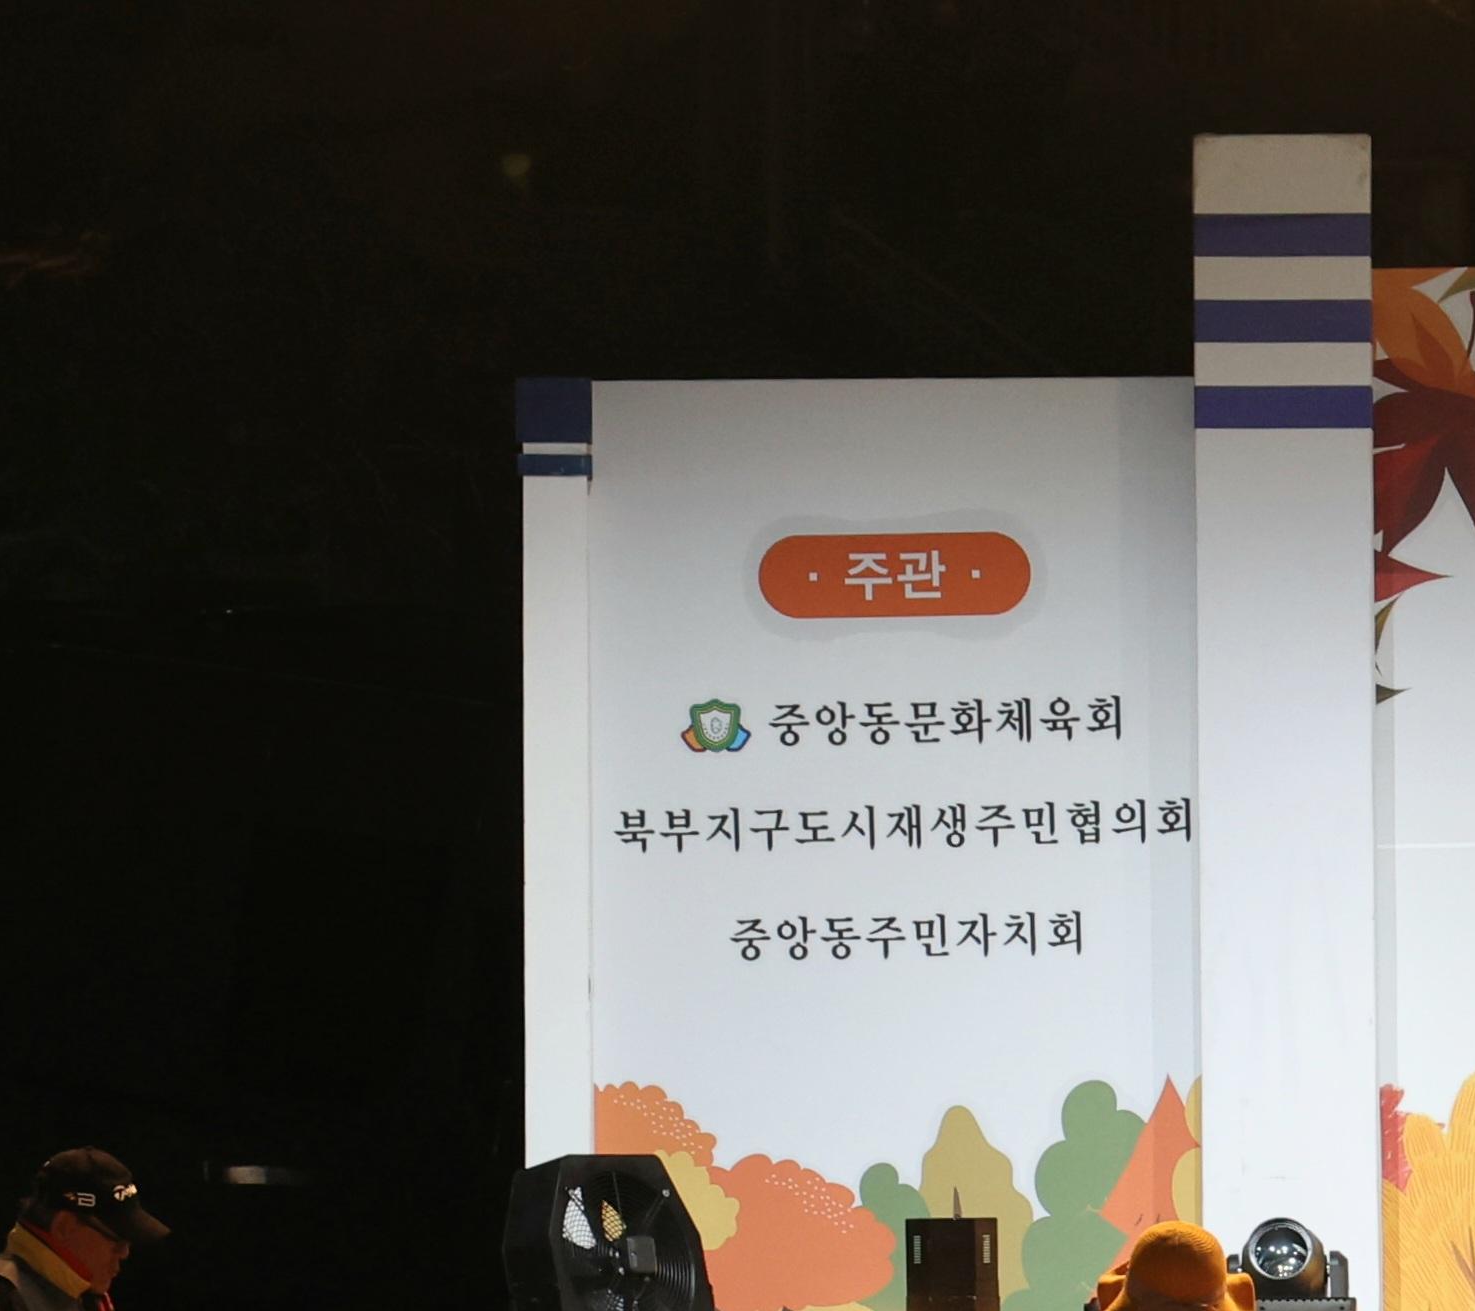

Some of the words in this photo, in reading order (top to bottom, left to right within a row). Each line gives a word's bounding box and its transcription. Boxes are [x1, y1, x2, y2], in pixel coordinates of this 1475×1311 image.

[844, 550, 946, 601] 주관
[768, 694, 1122, 747] 중앙동문화체육회
[613, 796, 1193, 854] 북부지구도시재생주민협의회
[729, 909, 1082, 962] 중앙동주민자치회
